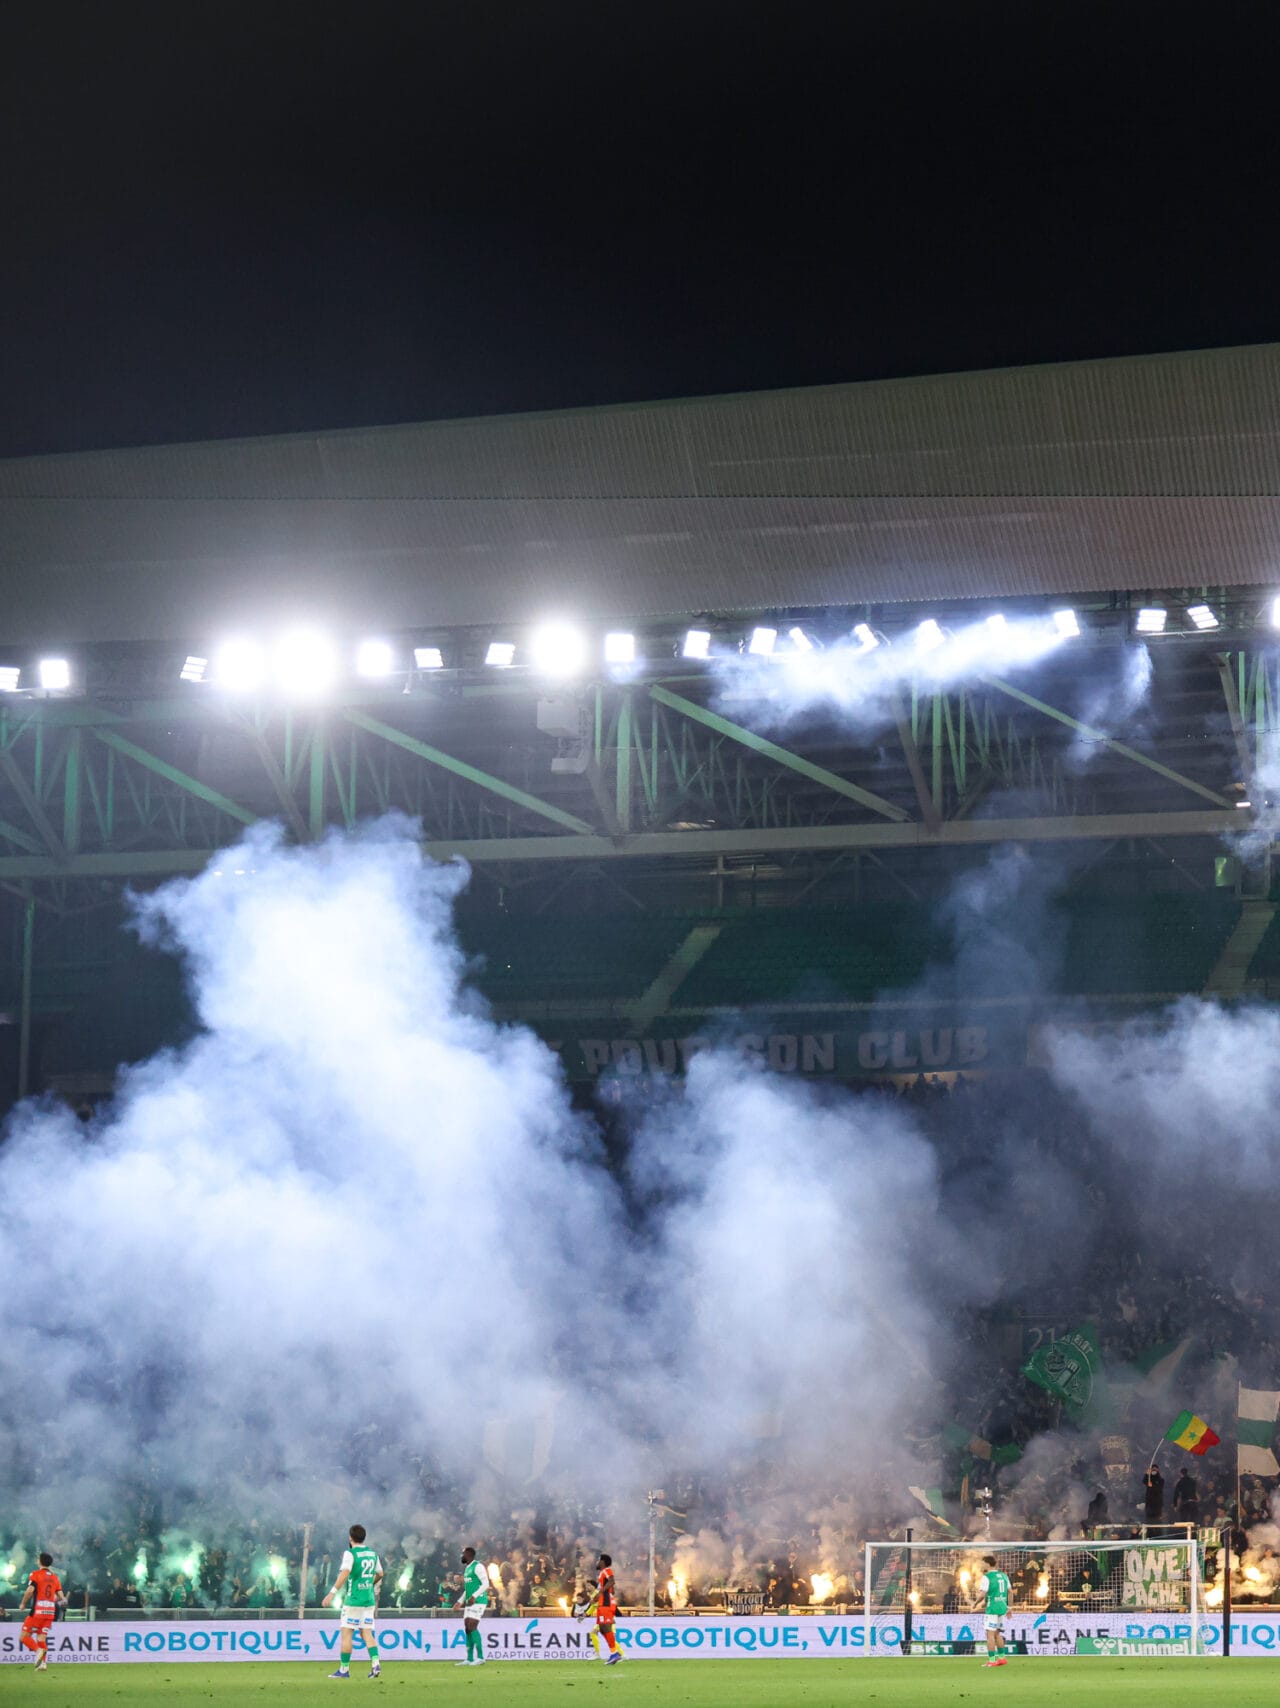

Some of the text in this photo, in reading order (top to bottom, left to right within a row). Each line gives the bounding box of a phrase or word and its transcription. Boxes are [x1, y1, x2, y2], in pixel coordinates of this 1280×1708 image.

[858, 1027, 988, 1069] CLUB
[1028, 1327, 1056, 1352] 21
[361, 1559, 375, 1578] 22
[1127, 1548, 1183, 1583] ONE
[45, 1584, 52, 1599] 6
[124, 1630, 310, 1654] ROBOTIQUE,
[615, 1626, 808, 1651] ROBOTIQUE,
[544, 1650, 596, 1659] ROBOTIC
[912, 1644, 952, 1654] BKT
[976, 1644, 1017, 1654] BT
[1118, 1639, 1189, 1655] hummel
[4, 1654, 53, 1662] ADAPTE
[57, 1654, 109, 1662] ROBOTICS
[487, 1651, 540, 1659] ADAPTIVE
